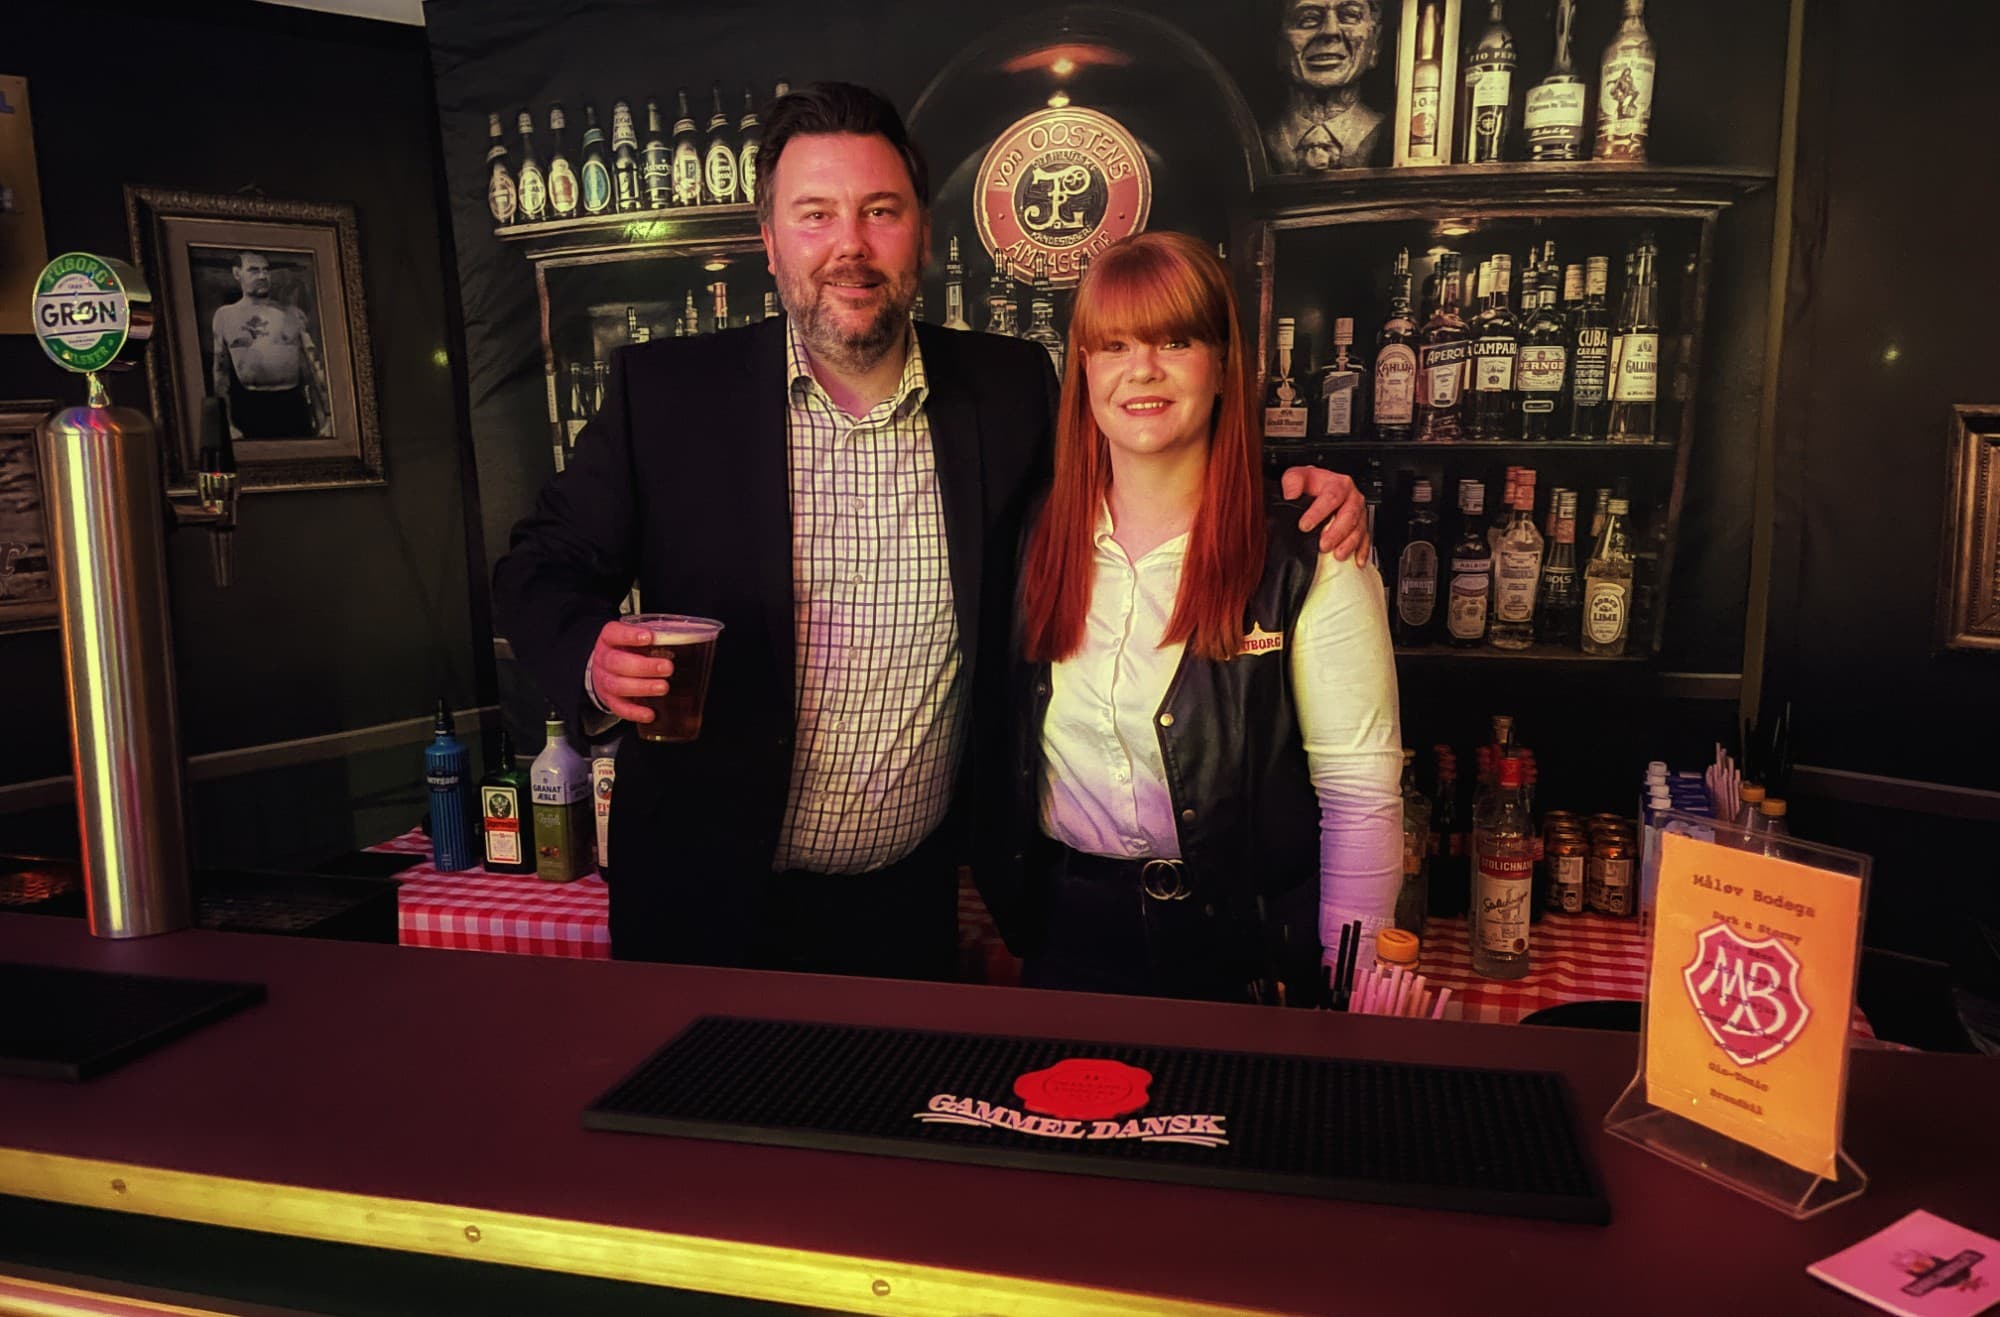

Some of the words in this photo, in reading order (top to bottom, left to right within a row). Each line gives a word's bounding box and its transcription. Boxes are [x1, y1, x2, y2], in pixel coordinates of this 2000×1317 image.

[1028, 123, 1132, 180] OOSTENS
[44, 257, 109, 284] TUBORG
[41, 301, 118, 328] GRØN
[1578, 329, 1608, 347] CUBA
[1426, 347, 1465, 365] APEROL
[1593, 612, 1617, 621] LIME
[1244, 636, 1281, 650] UBORG
[533, 784, 561, 794] GRANAT
[1693, 874, 1744, 897] Måløv
[1753, 889, 1816, 918] Bodega
[928, 1093, 1086, 1140] GAMMEL
[1086, 1114, 1227, 1140] DANSK
